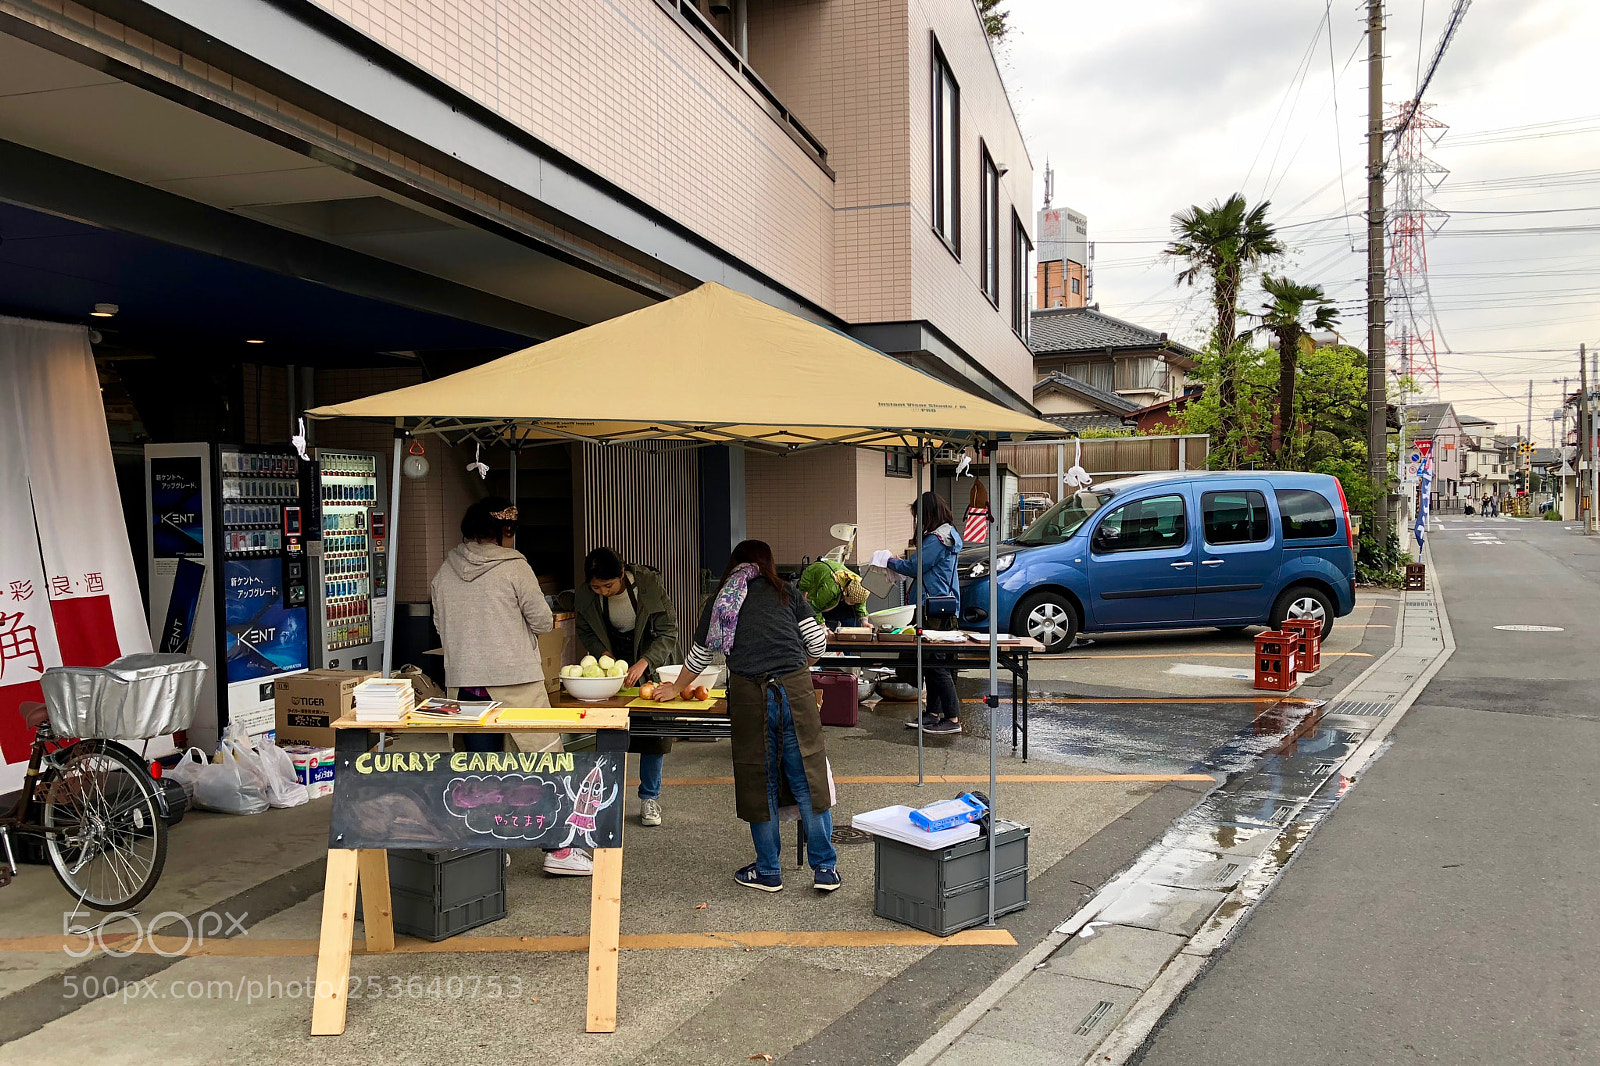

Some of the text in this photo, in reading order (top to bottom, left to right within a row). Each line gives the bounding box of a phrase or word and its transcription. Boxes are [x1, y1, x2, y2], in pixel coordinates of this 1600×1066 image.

[160, 512, 195, 524] KENT
[237, 626, 276, 647] KENT
[300, 697, 325, 706] TIGER
[355, 752, 575, 774] CURRY CARAVAN
[493, 814, 546, 829] やってます
